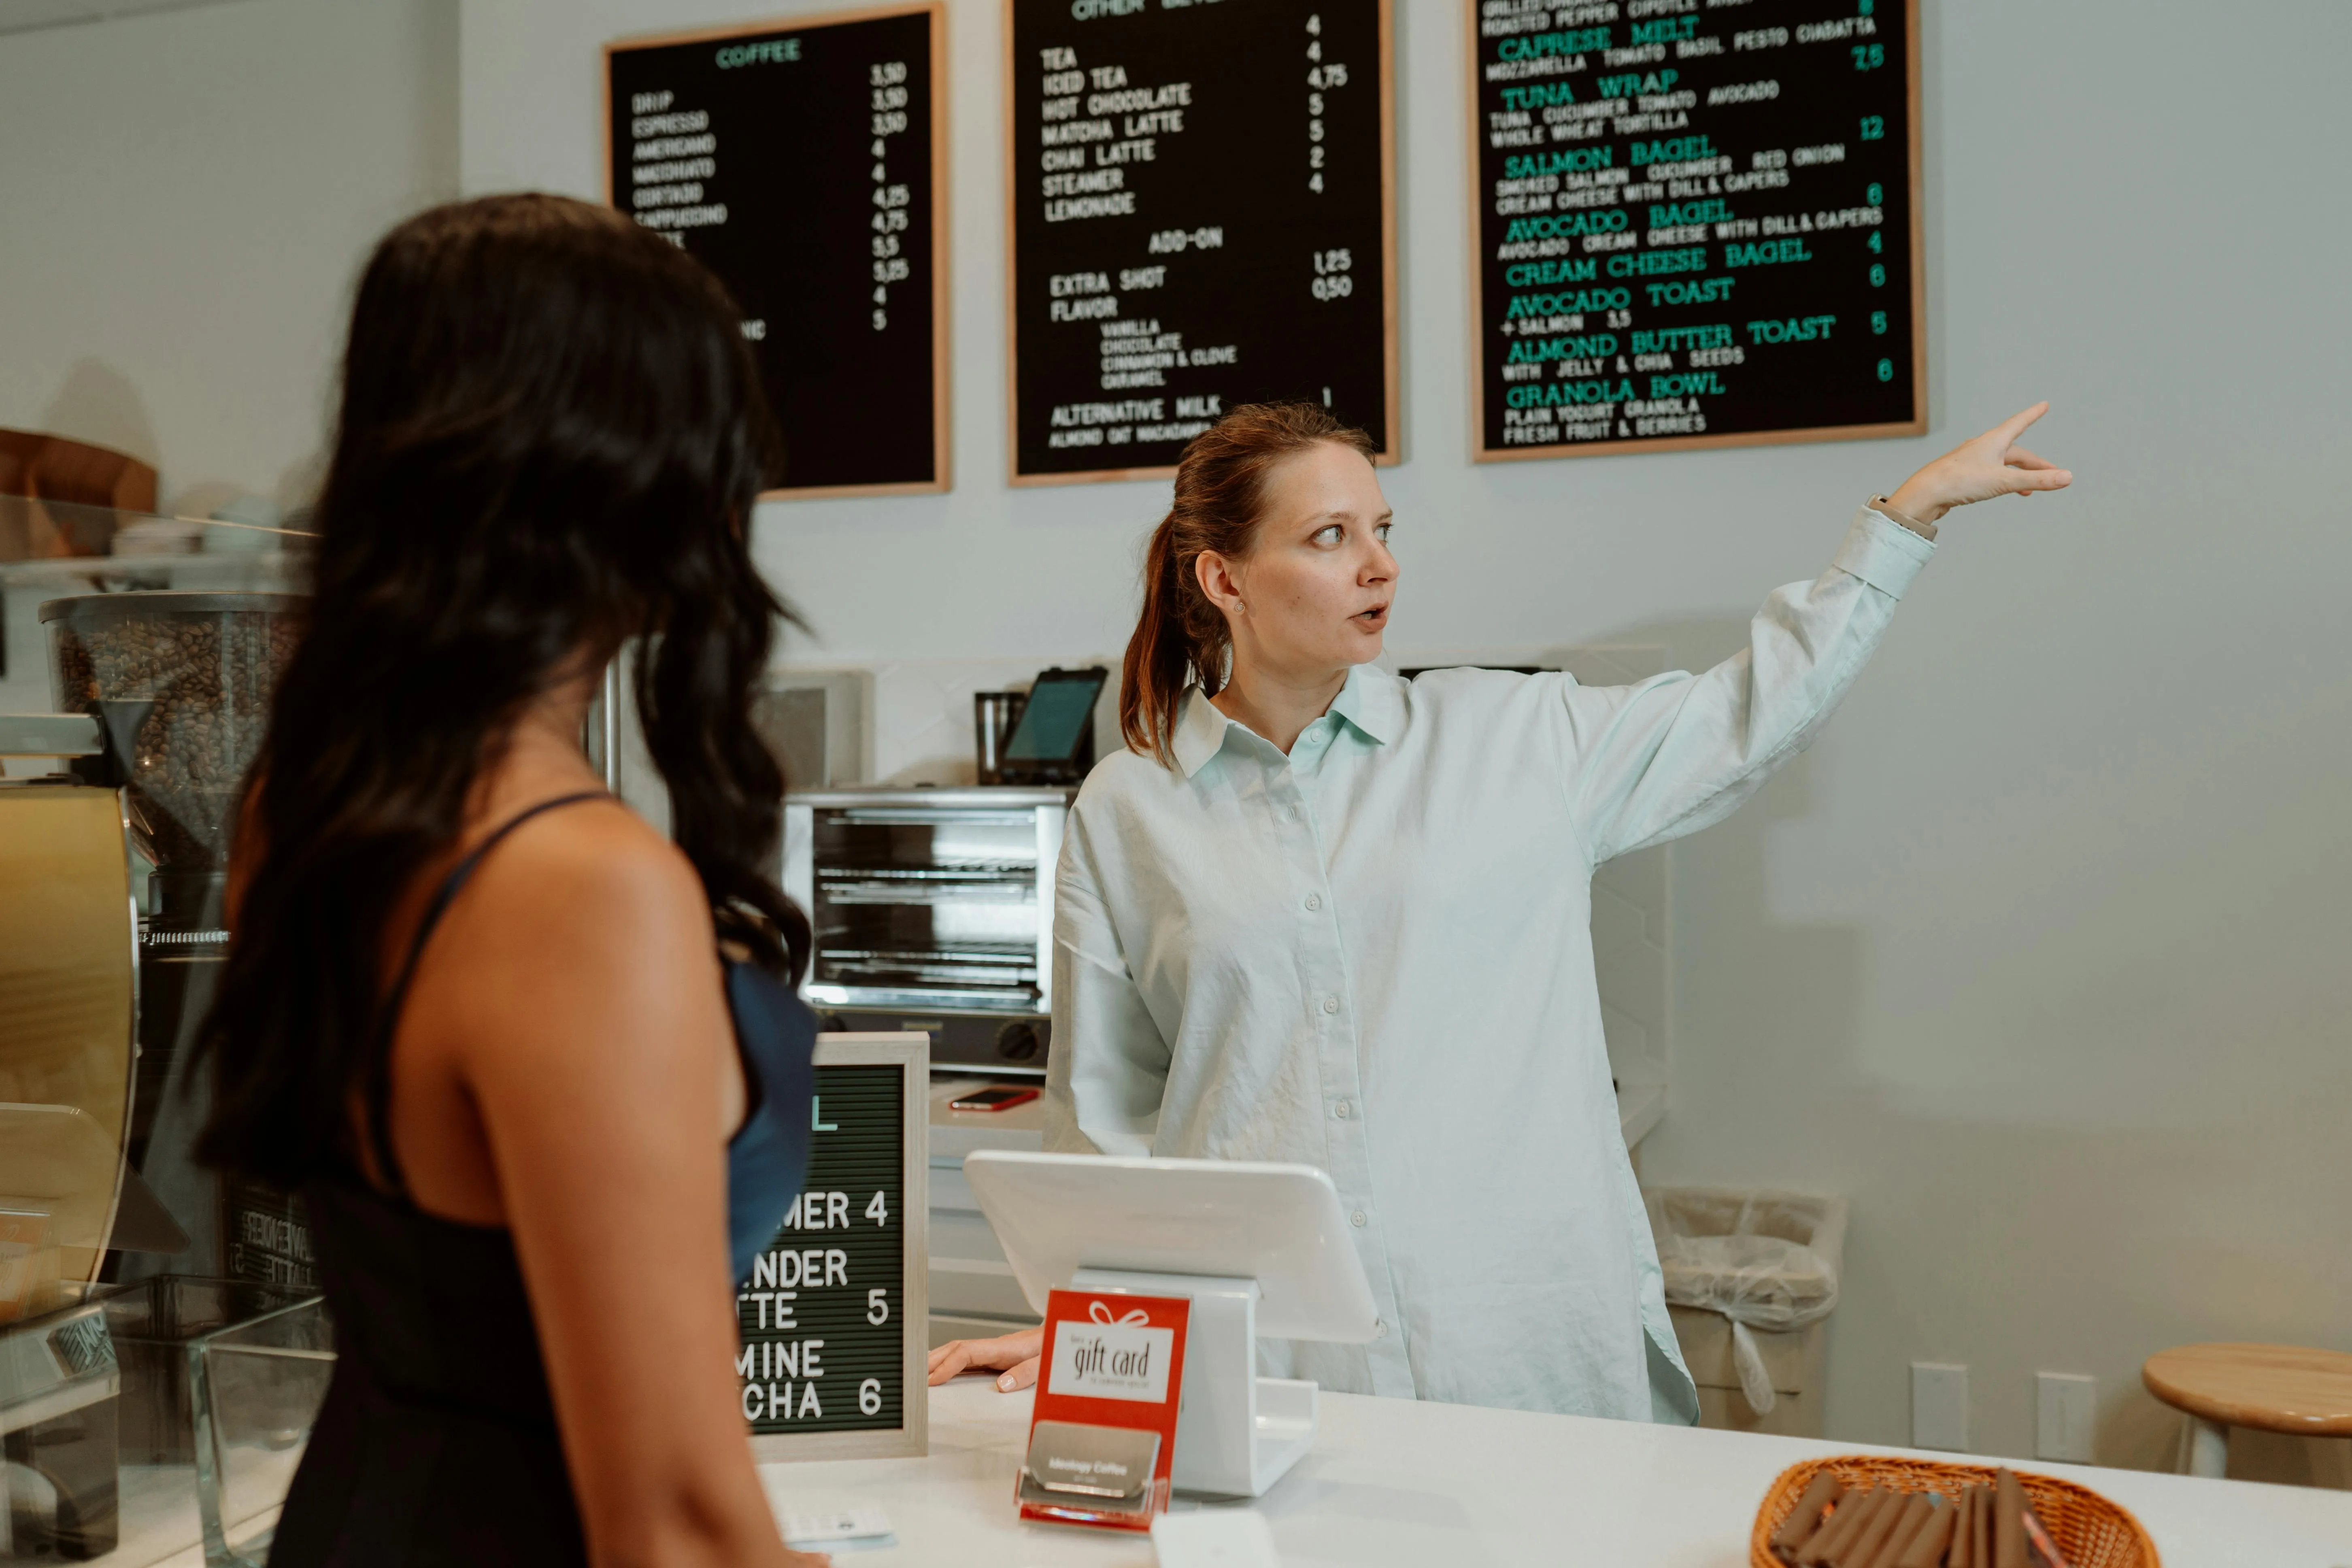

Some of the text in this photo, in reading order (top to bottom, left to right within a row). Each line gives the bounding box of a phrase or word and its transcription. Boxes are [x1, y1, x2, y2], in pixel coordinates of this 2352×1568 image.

[1306, 13, 1321, 36] 4
[1482, 11, 1550, 36] ROASTED
[1555, 2, 1619, 28] PEPPER
[1307, 40, 1322, 63] 4
[1486, 16, 1877, 81] MOZZARELLA TOMATO BASIL PESTO CIABATTA
[1498, 15, 1700, 61] CAPRESE MELT
[715, 38, 802, 69] COFFEE
[1040, 46, 1077, 71] TEA
[1043, 66, 1128, 96] ICED TEA
[1500, 68, 1678, 111] TUNA WRAP
[1042, 83, 1192, 121] HOT CHOCOLATE
[1309, 93, 1324, 116] 5
[1489, 79, 1780, 130] TUNA CUCUMBER TOMATO AVOCADO
[632, 110, 710, 139] ESPRESSO
[1042, 109, 1184, 146] MATCHA LATTE
[1309, 119, 1325, 143] 5
[1490, 111, 1689, 149] WHOLE WHEAT TORTILLA
[1860, 115, 1884, 140] 12
[633, 132, 717, 162] AMERICANO
[871, 138, 885, 158] 4
[1041, 139, 1156, 172] CHAI LATTE
[1310, 145, 1325, 169] 2
[1505, 134, 1717, 179] SALMON BAGEL
[871, 162, 885, 183] 4
[1042, 168, 1124, 198] STEAMER
[1309, 172, 1325, 194] 4
[1495, 143, 1845, 198] SMOKED SALMON CUCUMBER RED ONION
[1045, 192, 1136, 222] LEMONADE
[1495, 168, 1789, 216] CREAM CHEESE WITH DILL & CAPERS
[1497, 237, 1570, 260] AVOCADO
[1582, 230, 1637, 253] CREAM
[1647, 223, 1708, 247] CHEESE
[1715, 218, 1758, 240] WITH
[1815, 205, 1884, 230] CAPERS
[1506, 198, 1734, 243] AVOCADO BAGEL
[1148, 226, 1223, 254] ADD-ON
[1867, 230, 1882, 254] 4
[1506, 237, 1812, 287] CREAM CHEESE BAGEL
[1869, 263, 1886, 287] 6
[873, 285, 887, 306] 4
[1050, 265, 1167, 298] EXTRA SHOT
[1051, 296, 1117, 323] FLAVOR
[1507, 277, 1735, 319] AVOCADO TOAST
[873, 309, 887, 330] 5
[1100, 319, 1161, 338] VANILLA
[1518, 314, 1584, 336] SALMON
[1871, 311, 1887, 335] 5
[1100, 332, 1182, 355] CHOCOLATE
[1507, 315, 1837, 364] ALMOND BUTTER TOAST
[1100, 345, 1238, 373] CINNAMON & CLOVE
[1502, 345, 1745, 382] WITH JELLY & CHIA SEEDS
[1877, 357, 1893, 382] 6
[1100, 370, 1166, 390] CARAMEL
[1506, 372, 1726, 408] GRANOLA BOWL
[1051, 394, 1222, 427] ALTERNATIVE MILK
[1504, 396, 1700, 426] PLAIN YOGURT GRANOLA
[1048, 427, 1103, 448] ALMOND
[1108, 426, 1133, 445] OAT
[1503, 413, 1706, 445] FRESH FRUIT & BERRIES
[865, 1190, 888, 1227] 4
[742, 1249, 848, 1288] NDER
[867, 1289, 889, 1325] 5
[1075, 1339, 1150, 1380] gift card
[859, 1378, 881, 1415] 6
[1094, 1460, 1127, 1477] Coffee
